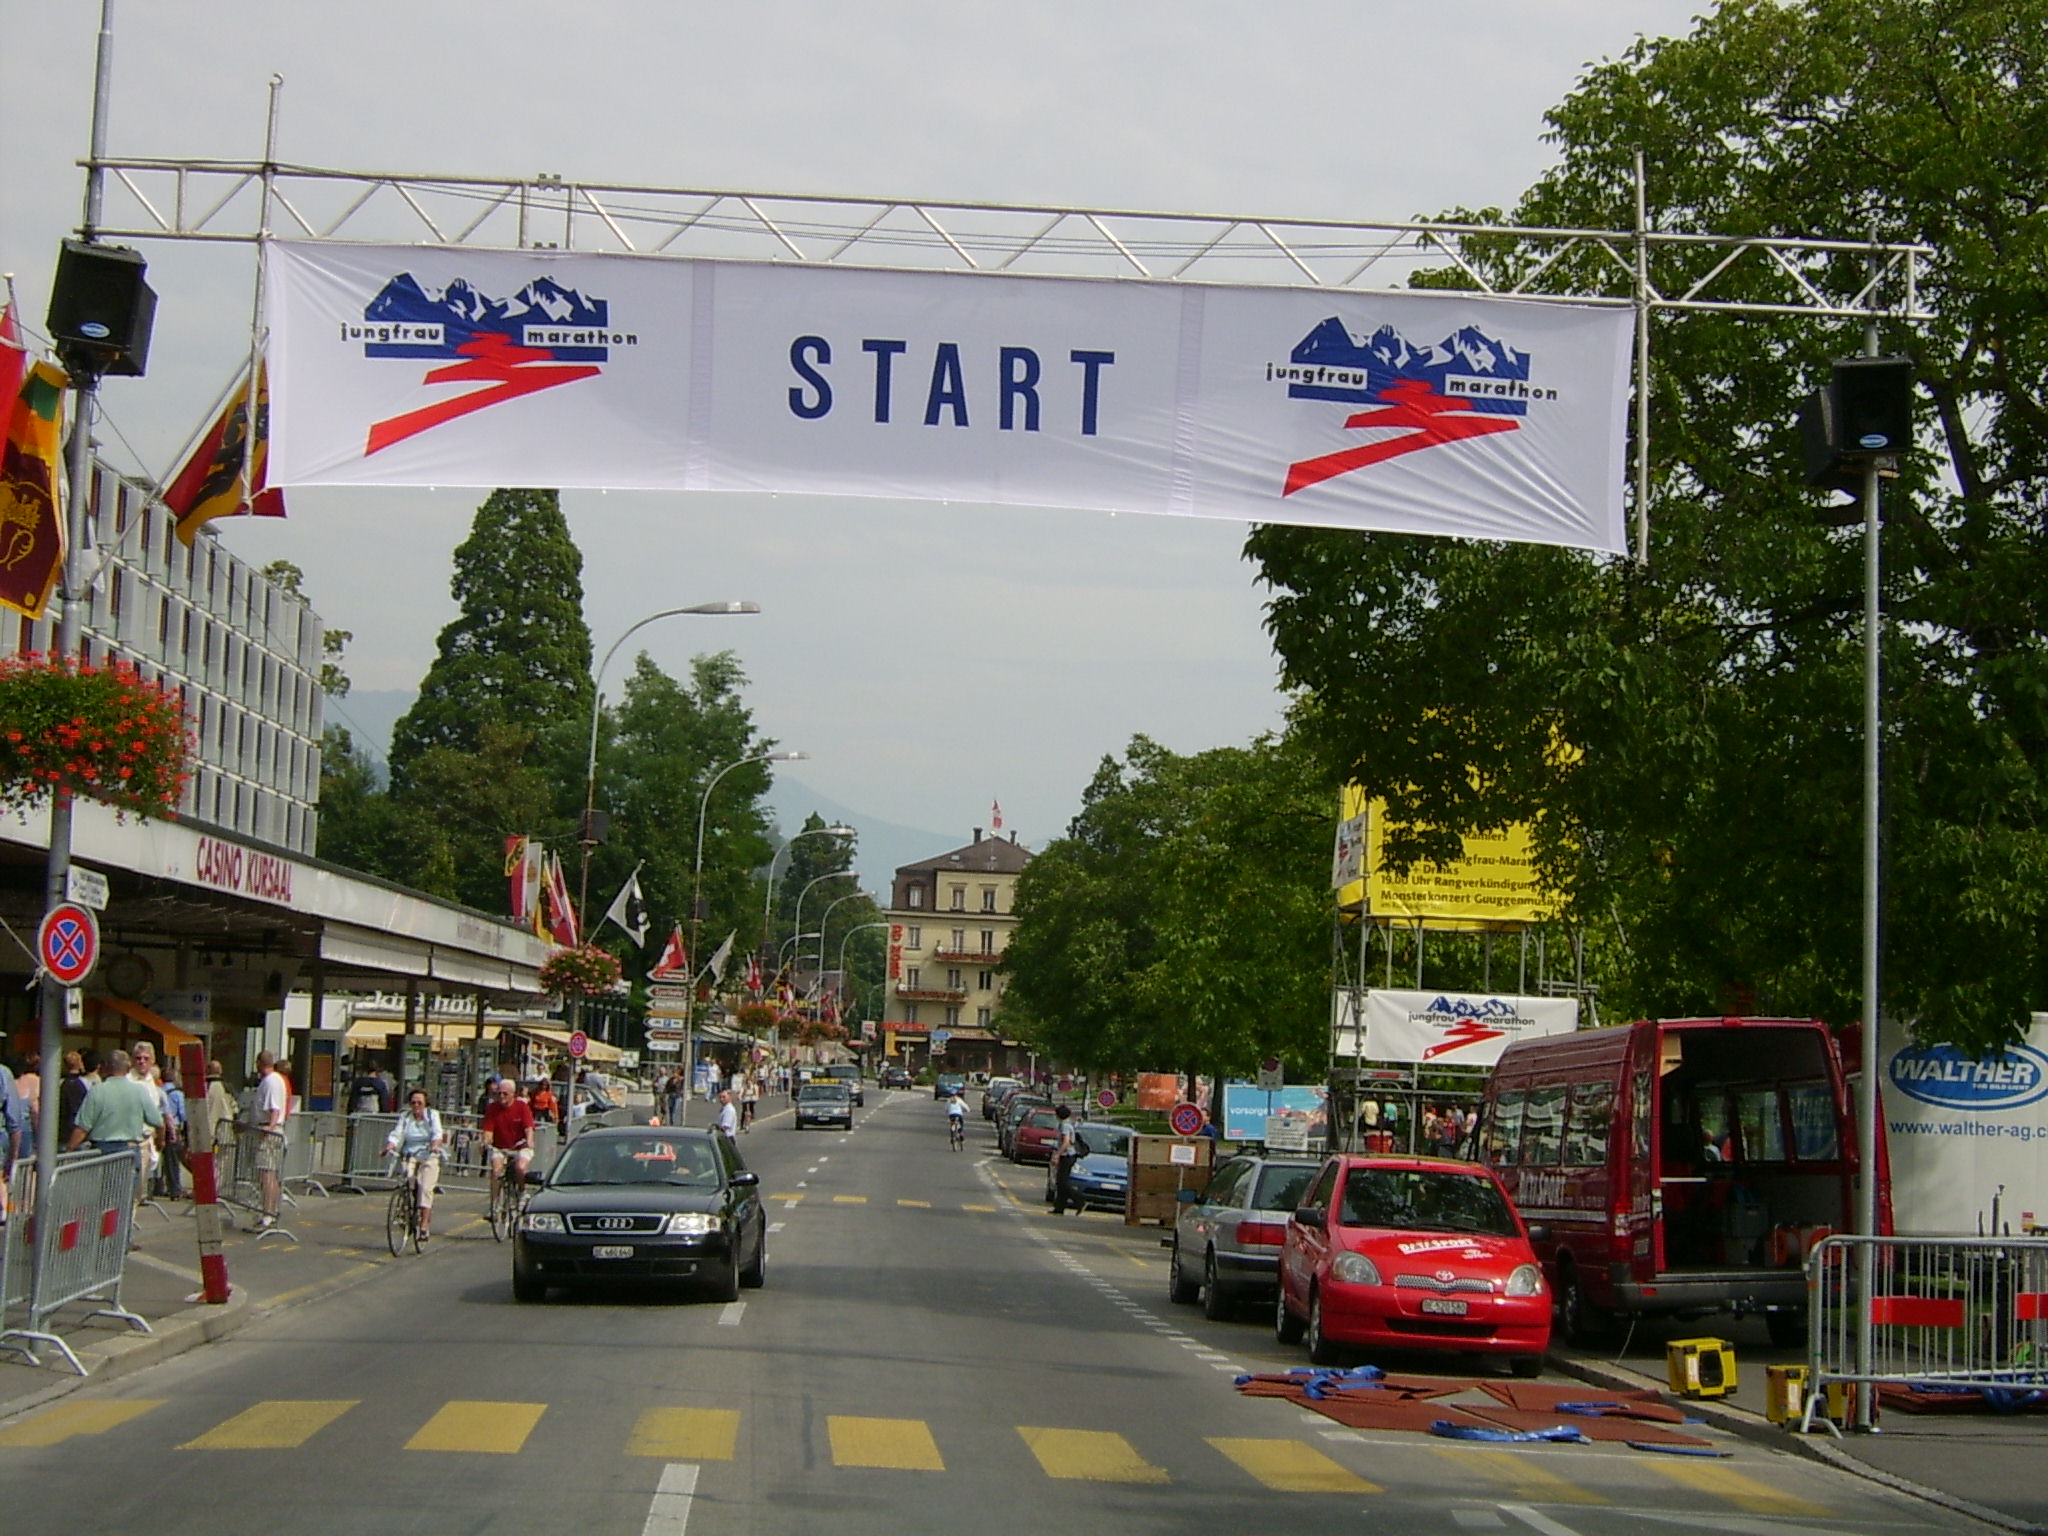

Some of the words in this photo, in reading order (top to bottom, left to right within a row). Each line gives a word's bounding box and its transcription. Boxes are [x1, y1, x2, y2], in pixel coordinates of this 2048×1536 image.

[340, 321, 442, 342] jungfrau
[526, 324, 638, 345] marathon
[788, 335, 1116, 436] START
[1266, 362, 1364, 386] jungfrau
[1449, 375, 1558, 400] marathon
[197, 837, 242, 890] CASINO
[246, 847, 292, 902] KURSAAL
[1411, 875, 1431, 887] Uhr
[1381, 890, 1470, 903] Monsterkonzert
[1408, 1011, 1455, 1023] jungfrau
[1482, 1015, 1535, 1026] marathon
[1895, 1059, 2033, 1084] WALTHER
[1890, 1121, 2048, 1141] www.walther-ag.c
